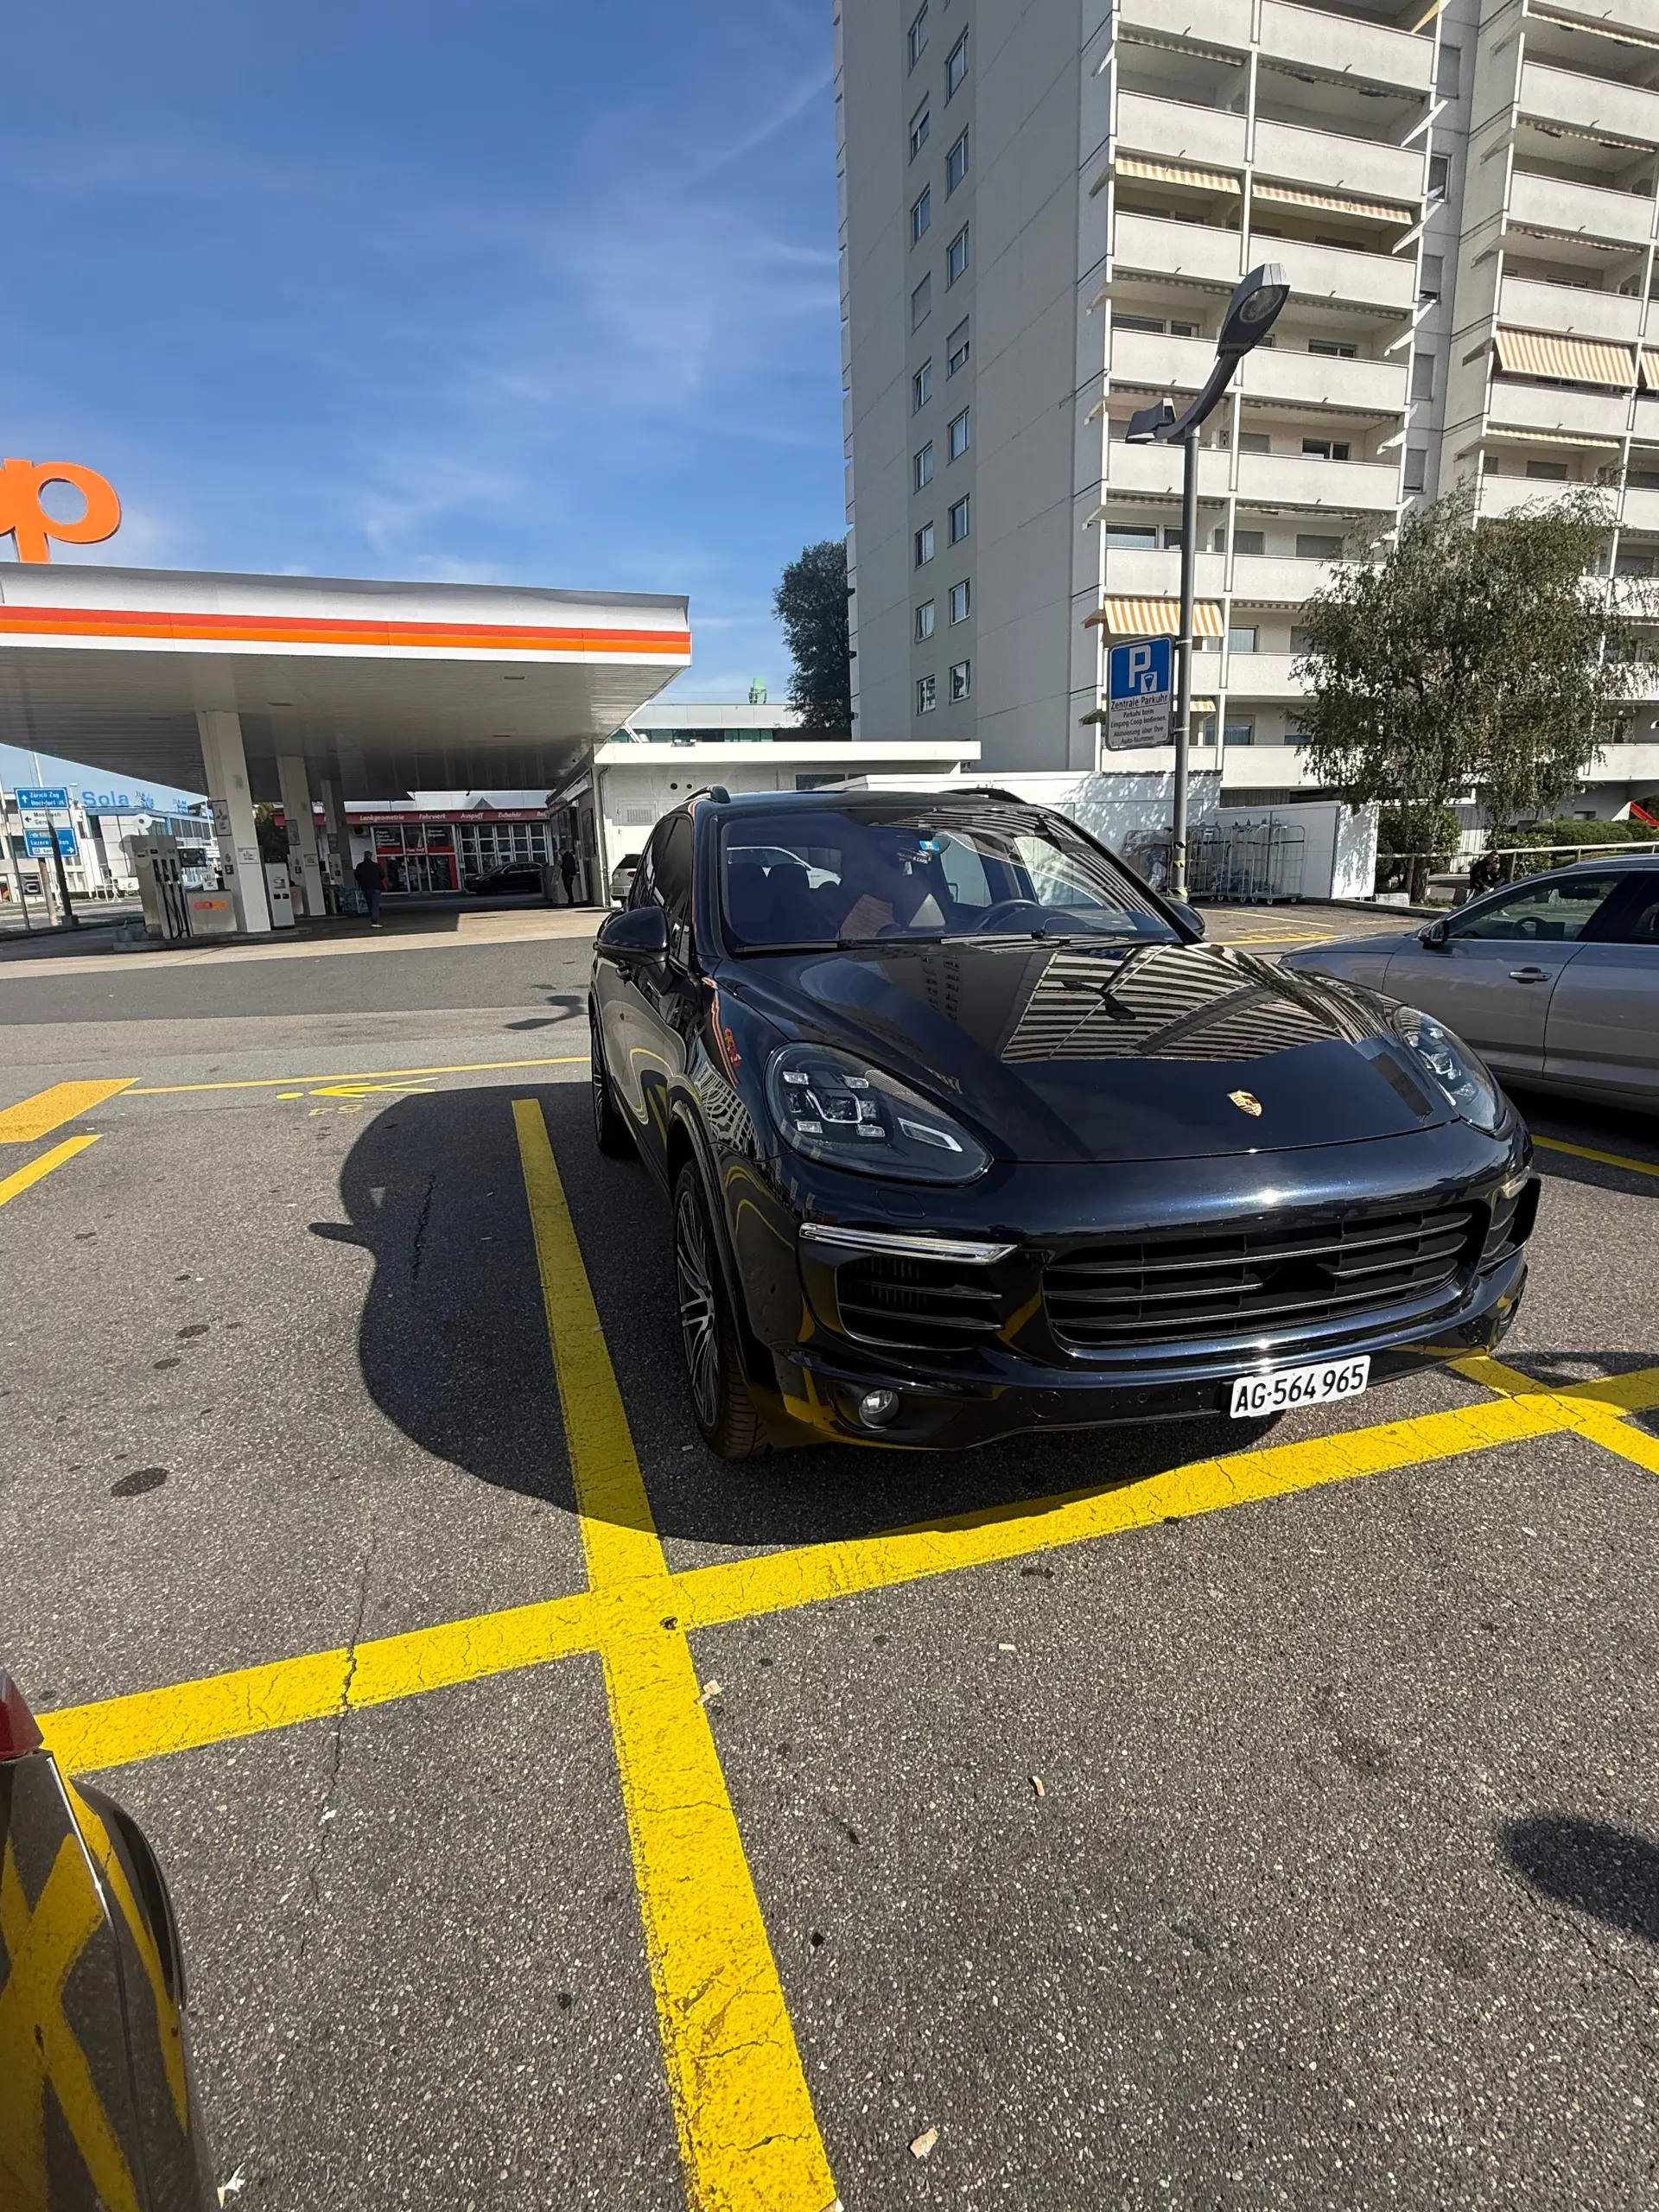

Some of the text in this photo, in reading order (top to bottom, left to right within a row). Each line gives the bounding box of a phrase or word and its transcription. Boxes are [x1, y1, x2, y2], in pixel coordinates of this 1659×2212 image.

[1128, 645, 1151, 688] P
[1110, 694, 1168, 710] Zentrale Parkuhr
[1110, 720, 1129, 729] Eingang
[1130, 718, 1142, 727] Coop
[81, 790, 130, 807] Sola
[359, 814, 405, 823] Lenkgeometrie
[461, 811, 484, 820] Auspuff
